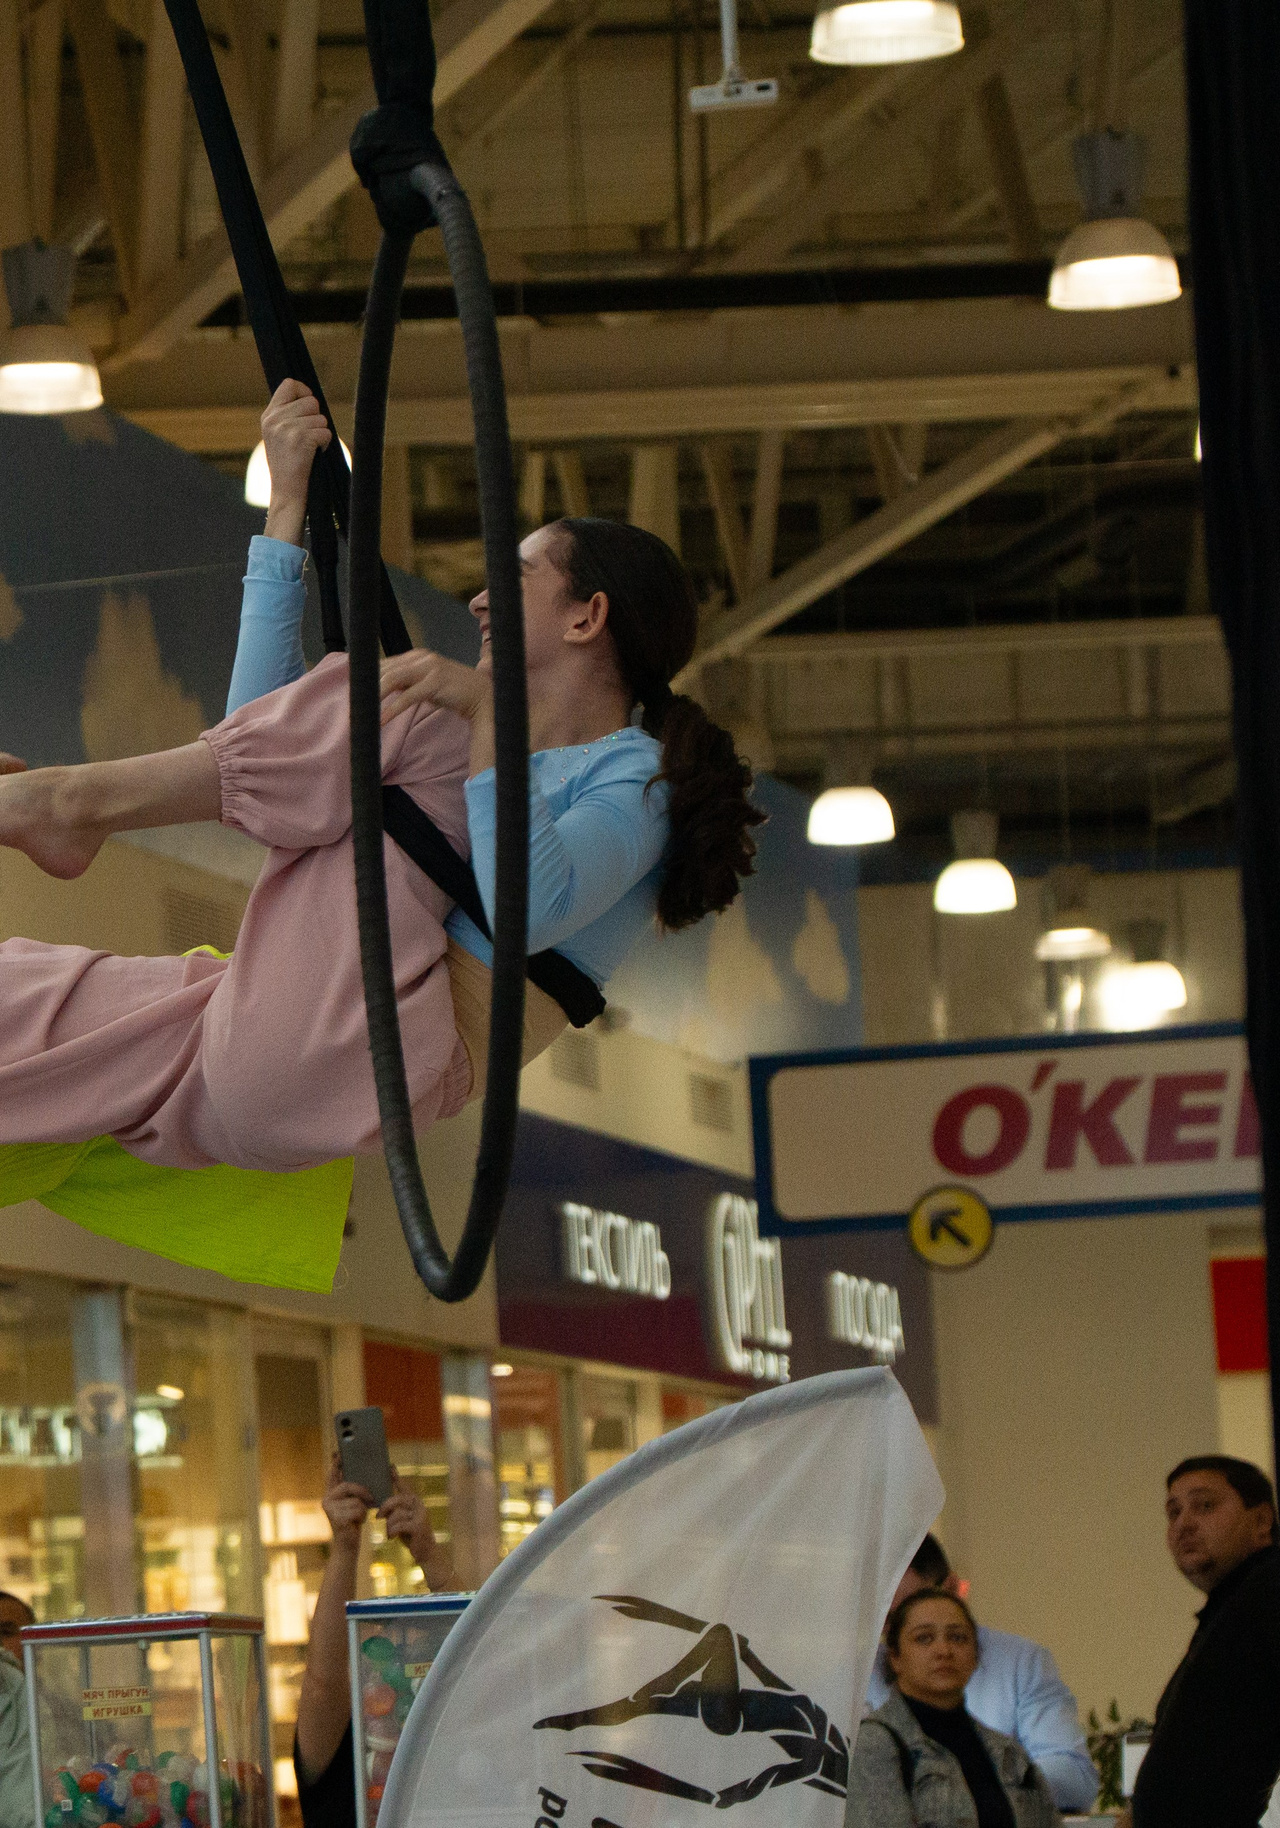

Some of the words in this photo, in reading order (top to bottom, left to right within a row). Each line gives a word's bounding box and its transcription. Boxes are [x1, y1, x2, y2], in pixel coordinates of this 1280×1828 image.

[562, 1201, 671, 1300] ТЕКСТИЛЬ
[829, 1271, 905, 1366] ПОСУДА
[93, 1704, 144, 1718] ИГРУШКА
[108, 1687, 149, 1699] ПРЫГУН
